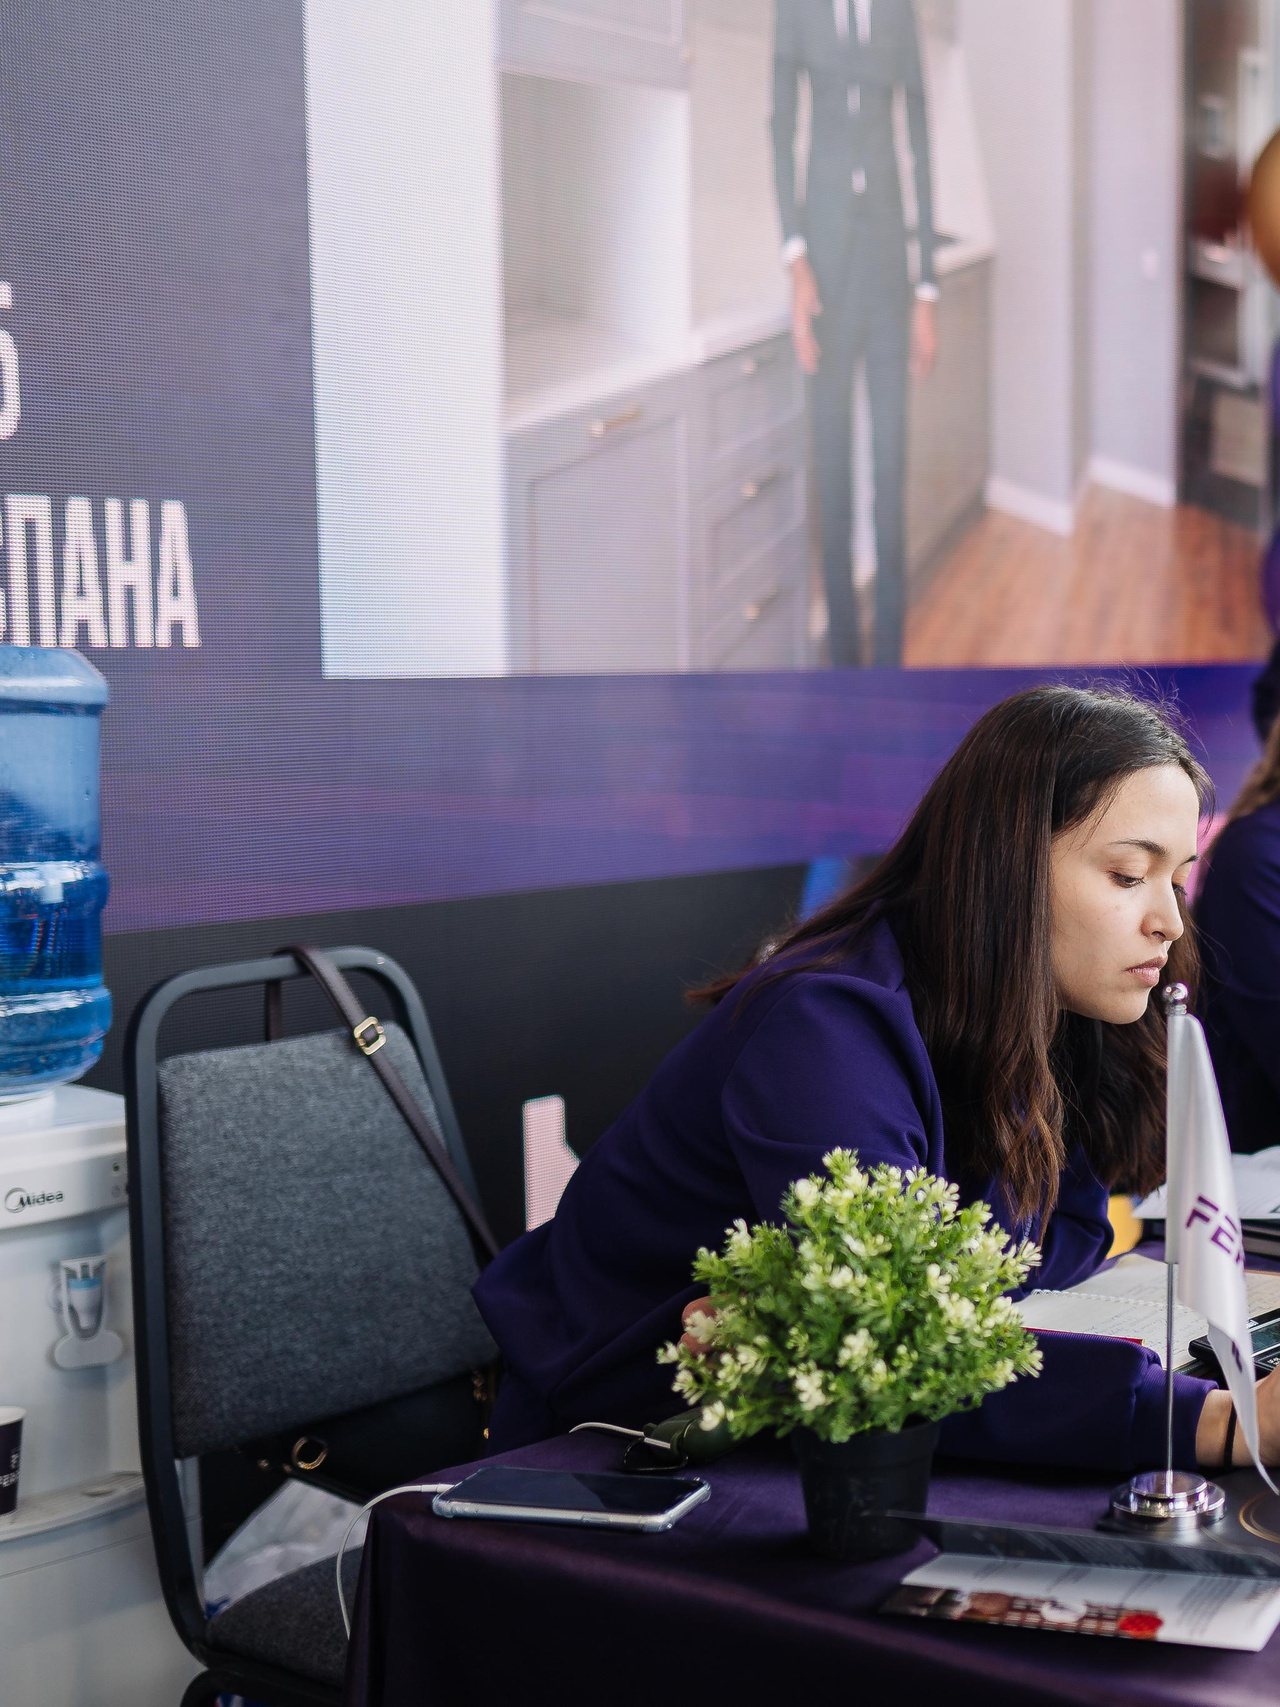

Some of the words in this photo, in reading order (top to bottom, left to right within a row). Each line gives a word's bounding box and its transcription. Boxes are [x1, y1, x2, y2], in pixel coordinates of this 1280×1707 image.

[0, 494, 202, 648] ПАНА
[6, 1188, 64, 1212] Midea
[1185, 1195, 1244, 1267] FE
